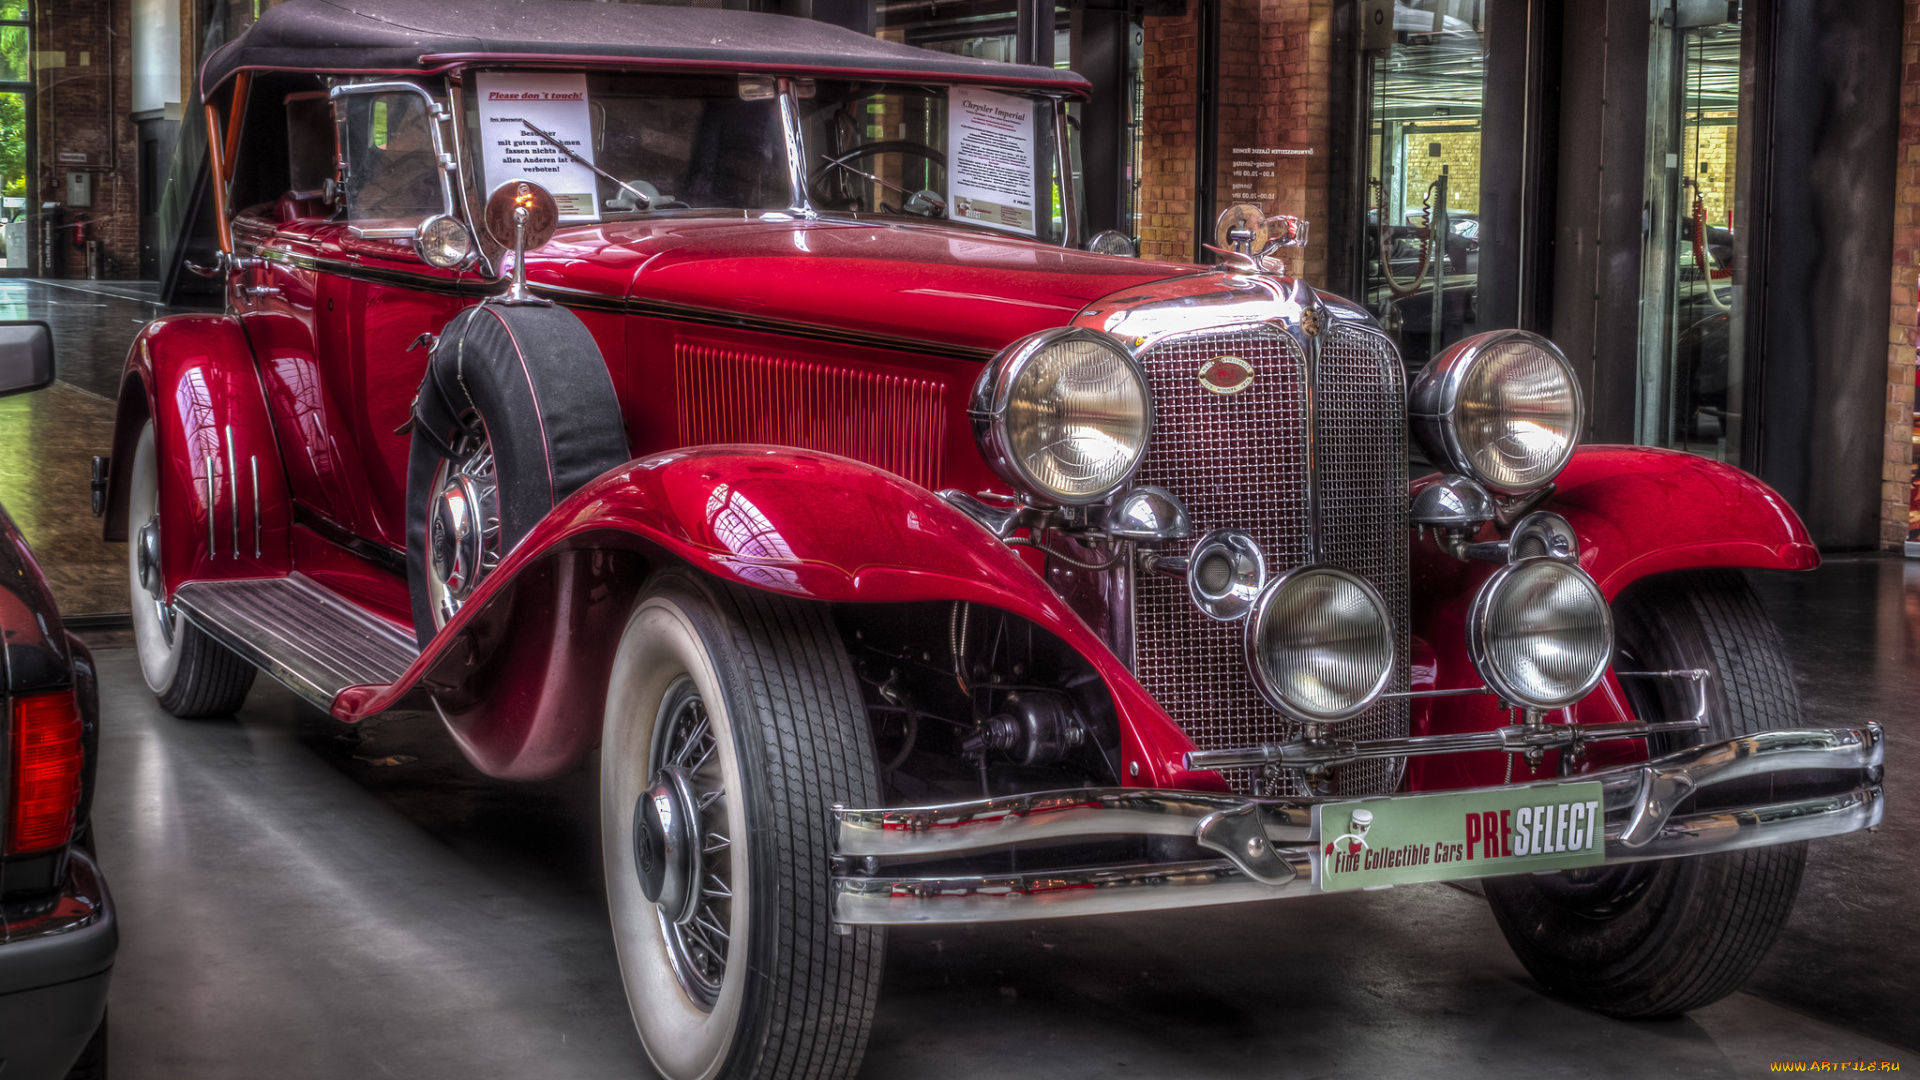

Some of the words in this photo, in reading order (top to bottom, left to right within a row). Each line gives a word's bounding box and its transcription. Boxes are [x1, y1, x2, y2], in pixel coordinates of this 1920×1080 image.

[489, 91, 519, 99] Please
[551, 91, 583, 99] touch!
[963, 100, 994, 113] Chrysler
[995, 107, 1026, 121] Imperial
[1335, 851, 1360, 873] Fine
[1364, 844, 1430, 870] Collectible
[1434, 842, 1463, 863] Cars
